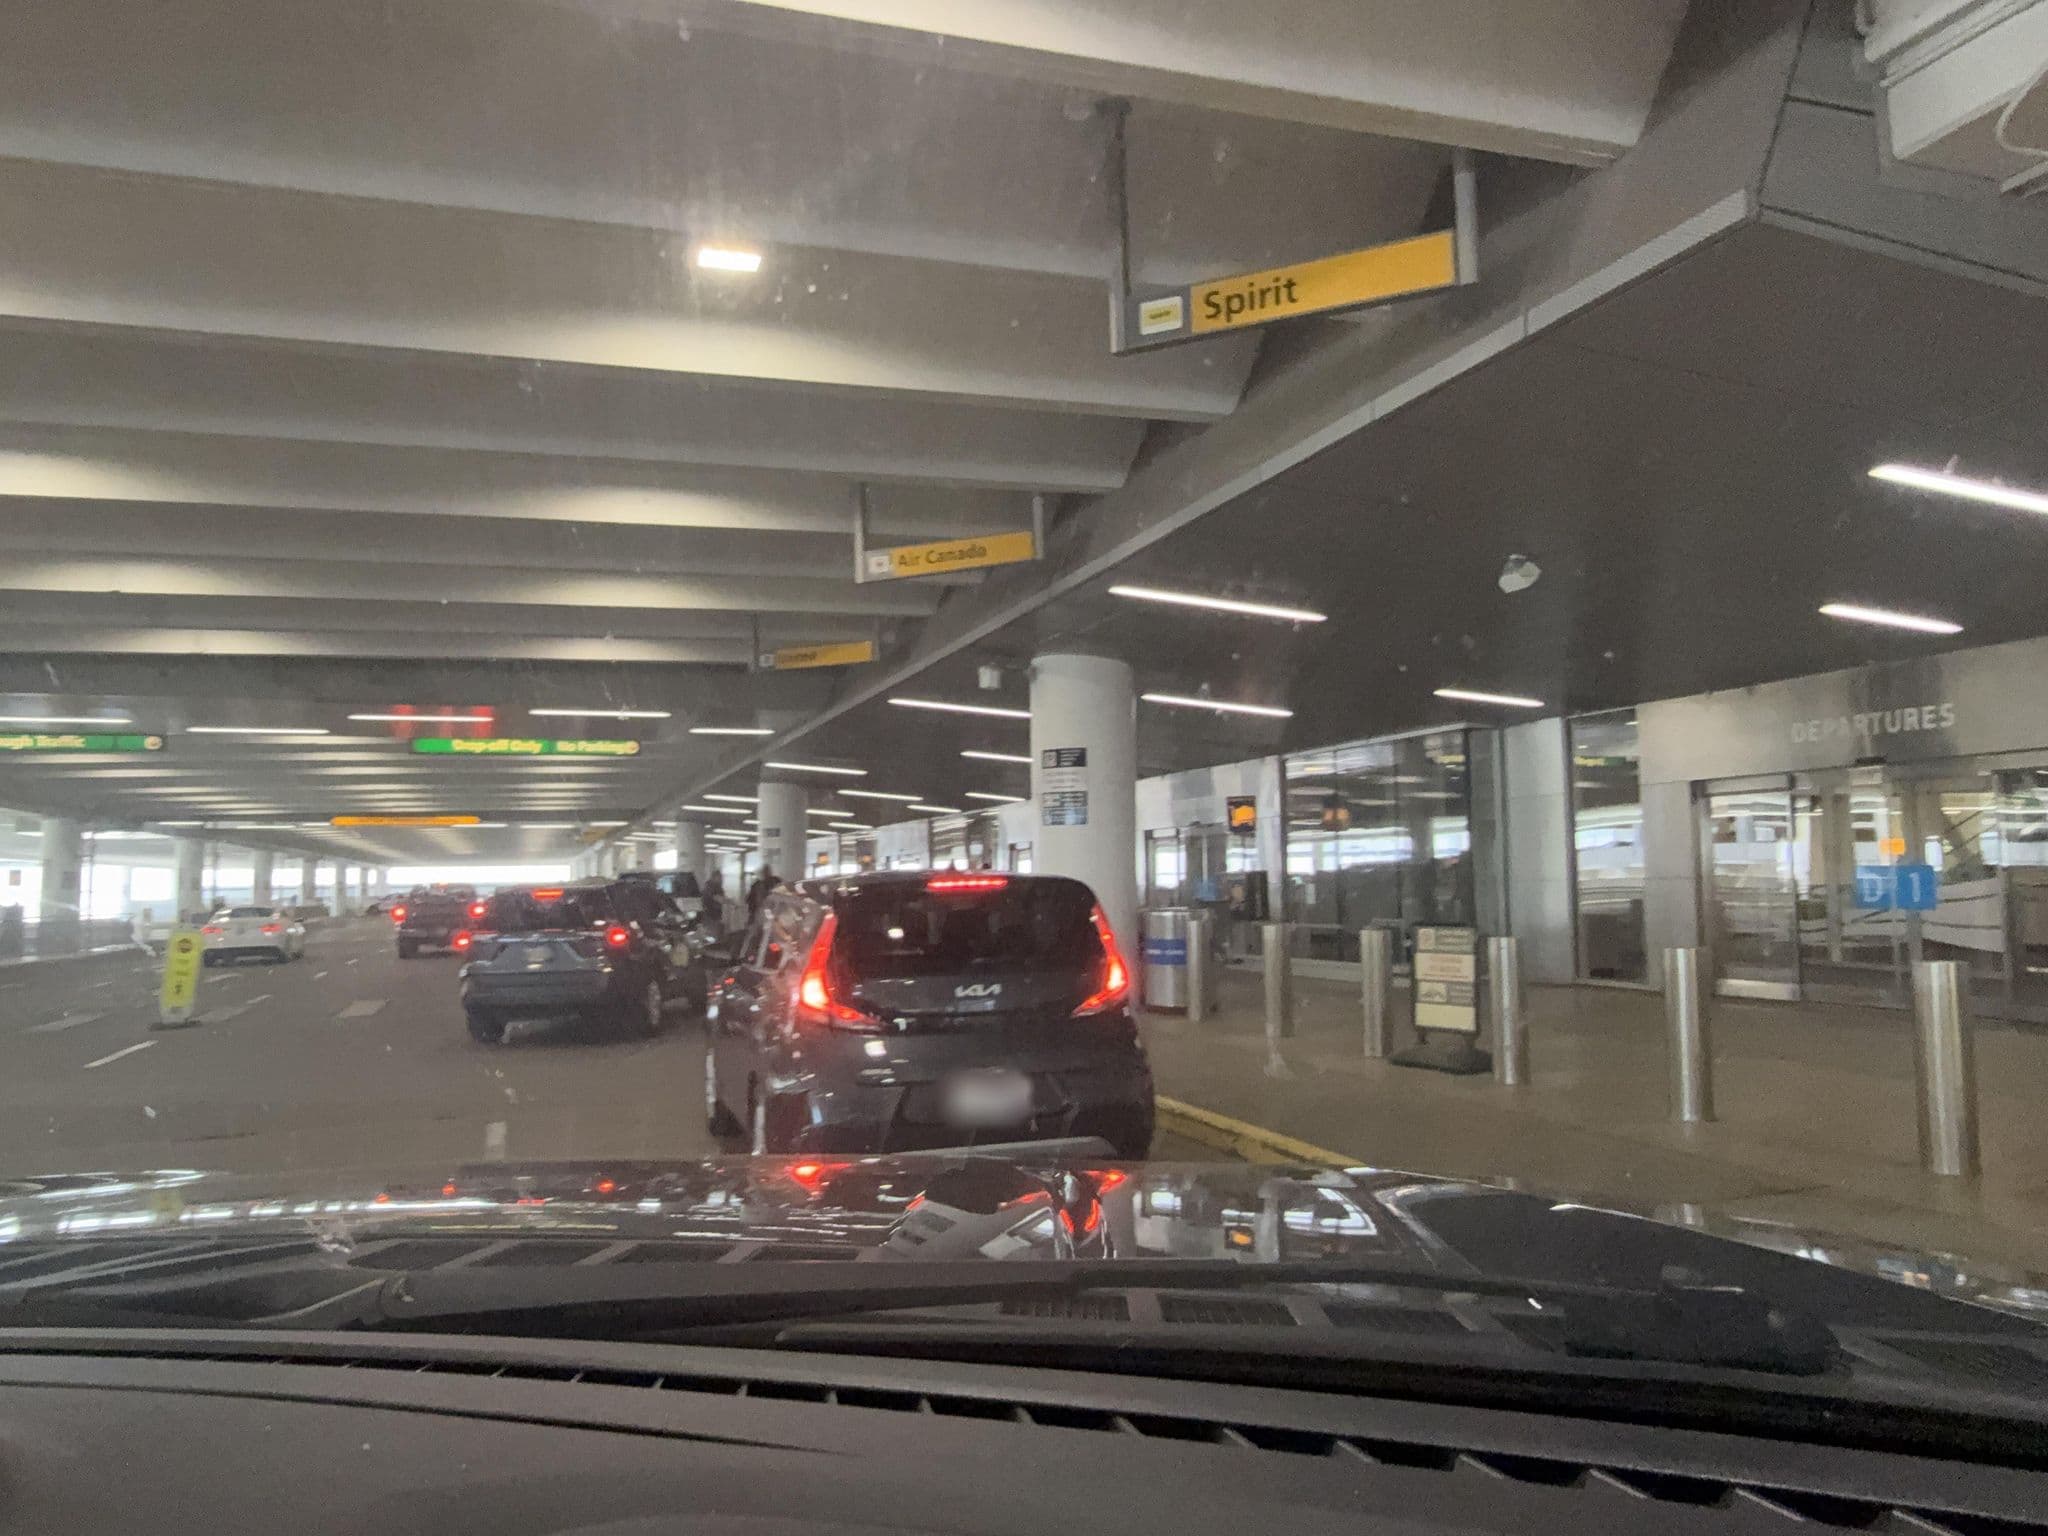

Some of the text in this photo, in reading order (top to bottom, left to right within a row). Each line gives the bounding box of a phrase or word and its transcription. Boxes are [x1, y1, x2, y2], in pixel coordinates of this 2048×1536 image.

[1203, 276, 1298, 322] Spirit
[899, 544, 987, 567] Air Canada
[1791, 703, 1956, 743] DEPARTURES
[1863, 872, 1921, 903] D 1
